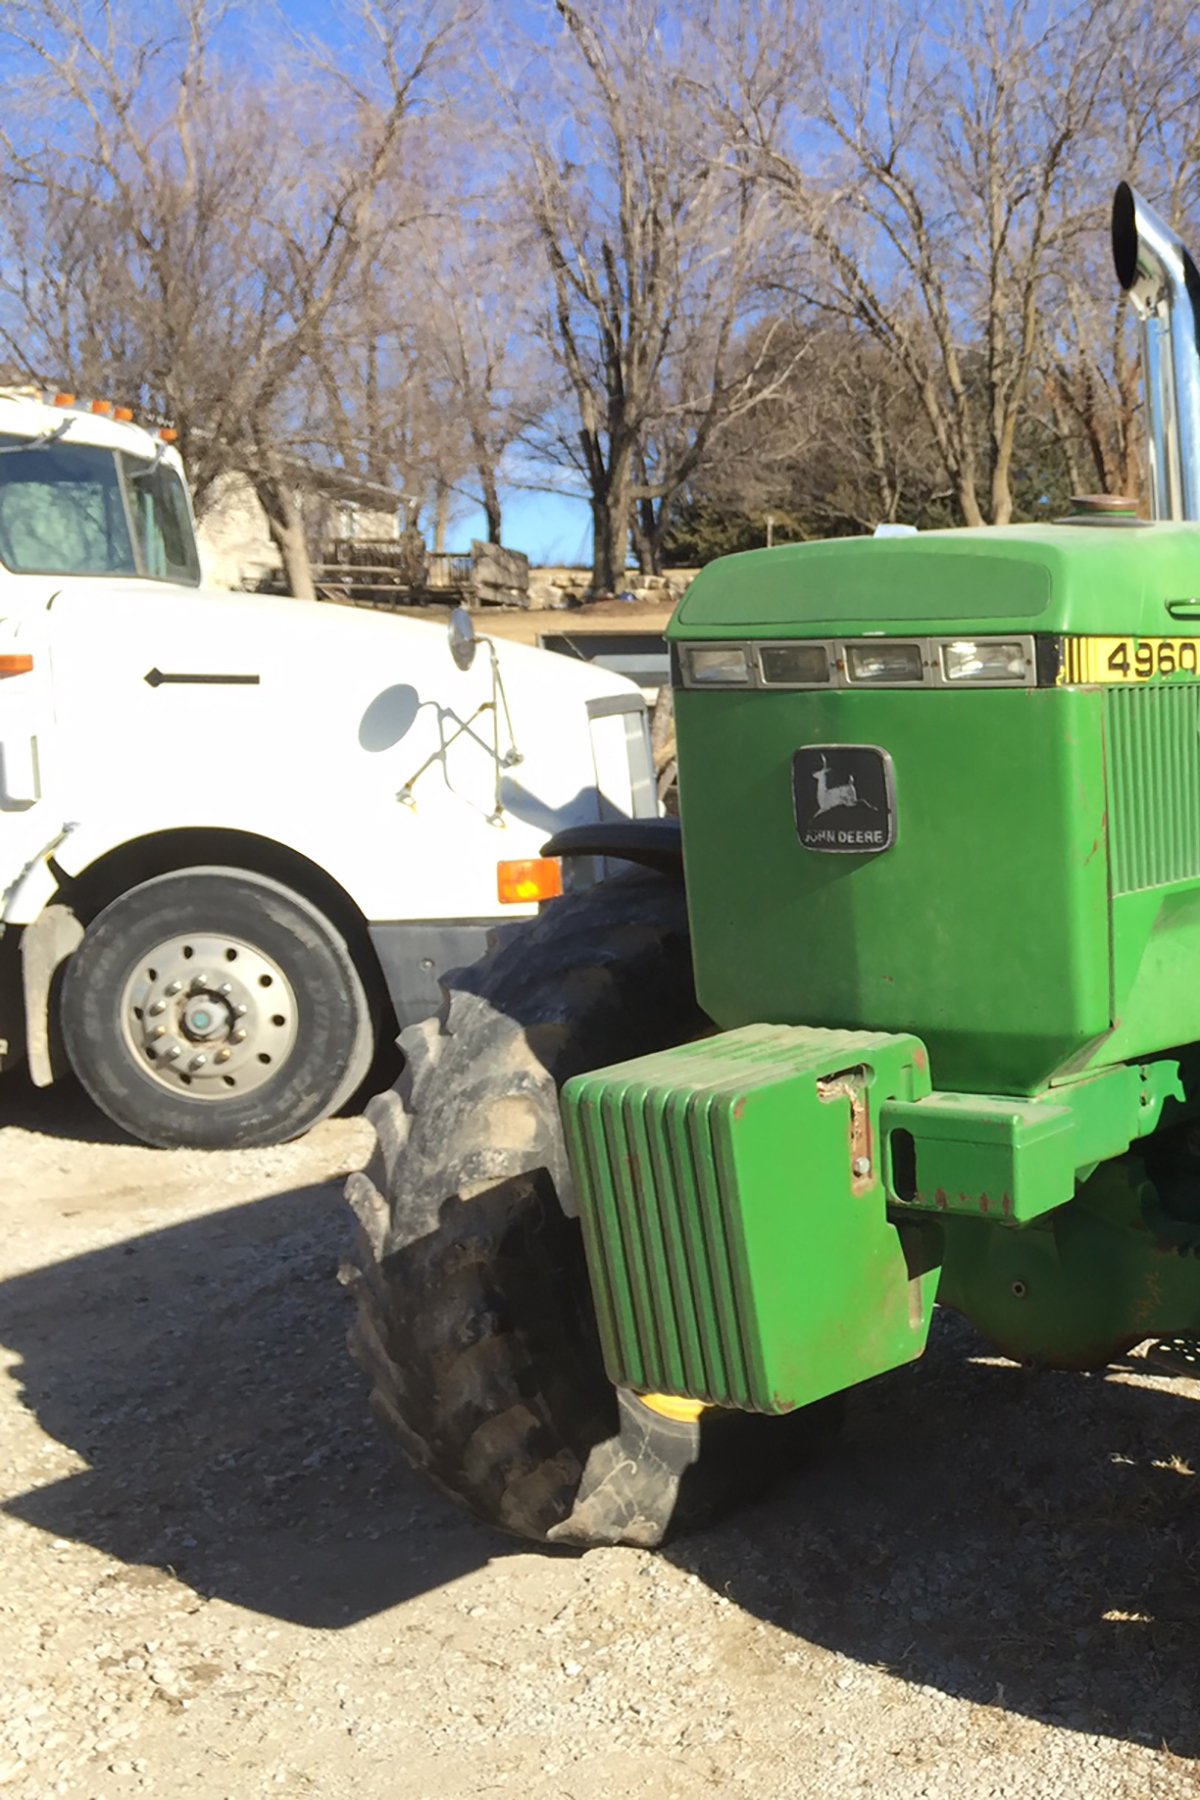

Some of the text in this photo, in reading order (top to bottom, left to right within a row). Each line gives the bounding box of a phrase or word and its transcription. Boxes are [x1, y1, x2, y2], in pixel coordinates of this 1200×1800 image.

[1107, 642, 1198, 678] 4960
[804, 829, 884, 844] JOHN DEERE
